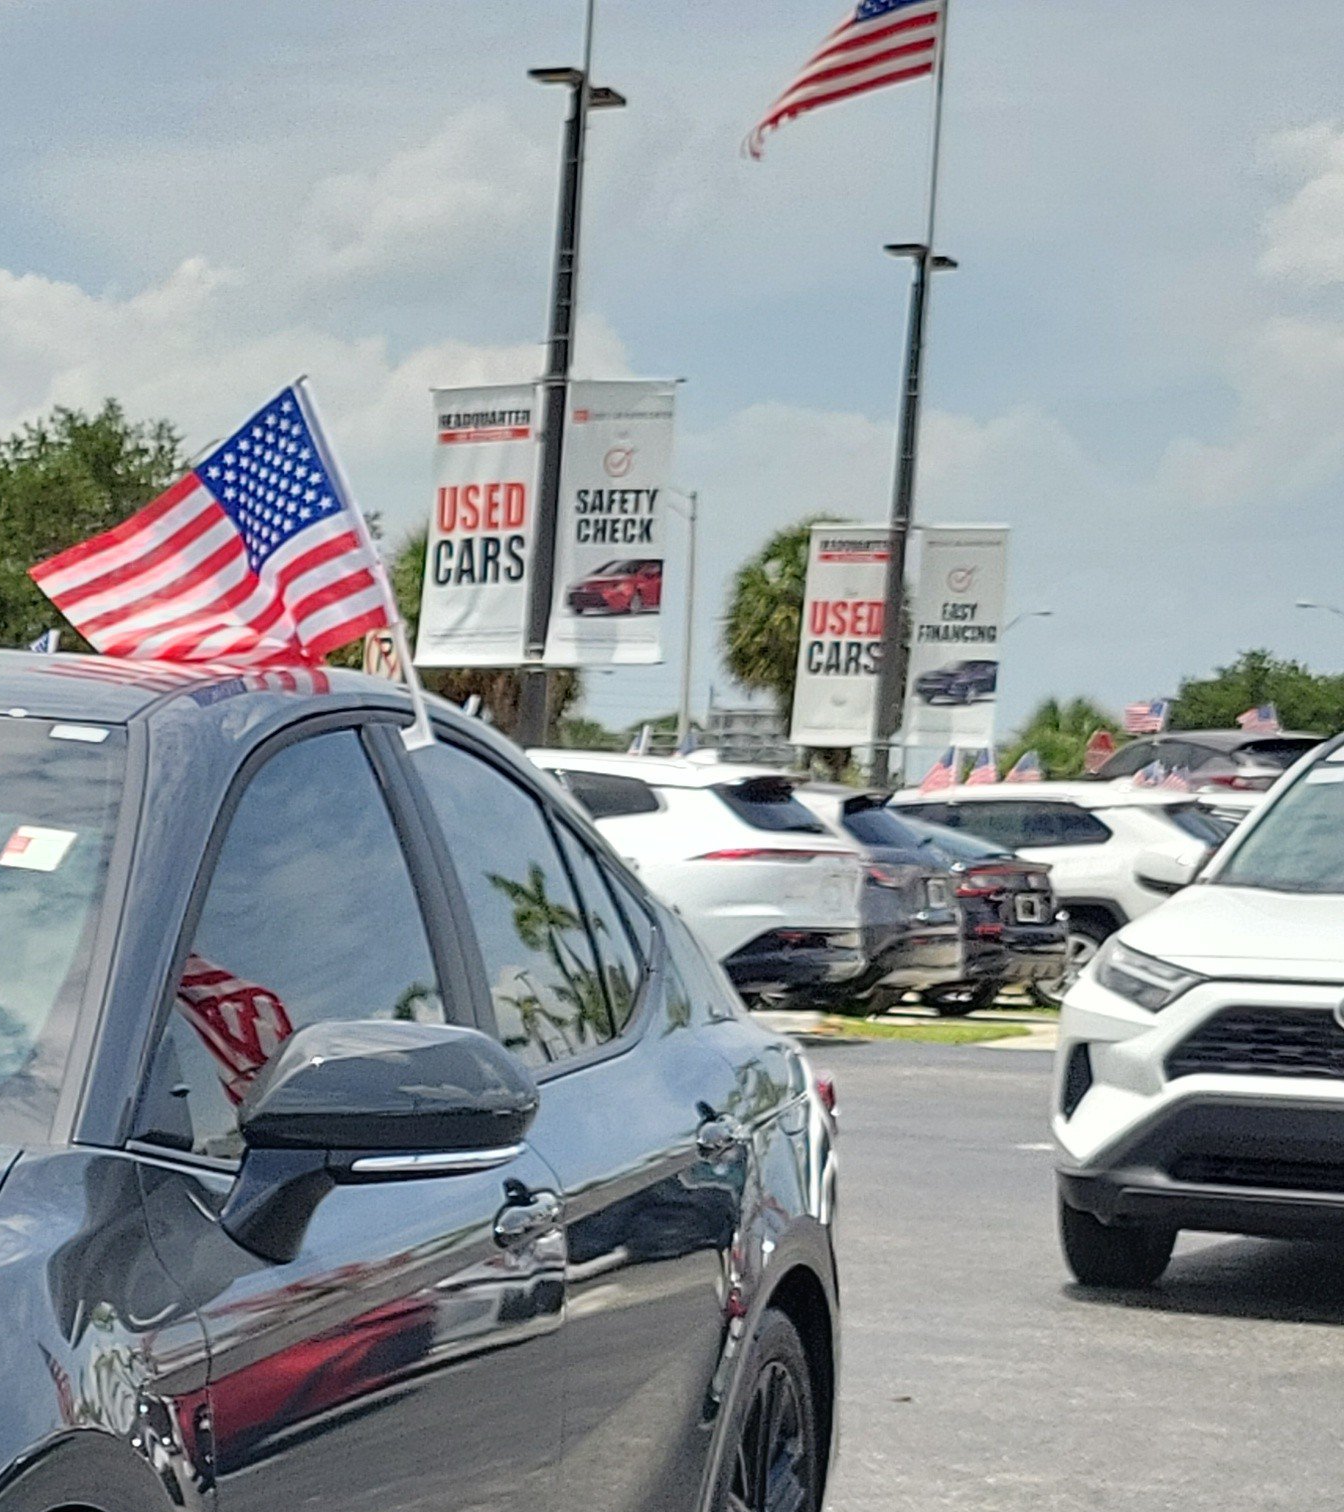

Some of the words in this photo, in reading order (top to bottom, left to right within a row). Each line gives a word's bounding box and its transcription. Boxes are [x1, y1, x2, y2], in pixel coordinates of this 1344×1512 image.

[438, 482, 525, 533] USED
[575, 488, 659, 514] SAFETY
[576, 517, 653, 544] CHECK
[433, 534, 525, 586] CARS
[811, 600, 884, 636] USED
[941, 602, 978, 621] EASY
[917, 624, 998, 643] FINANCING
[807, 640, 881, 675] CARS
